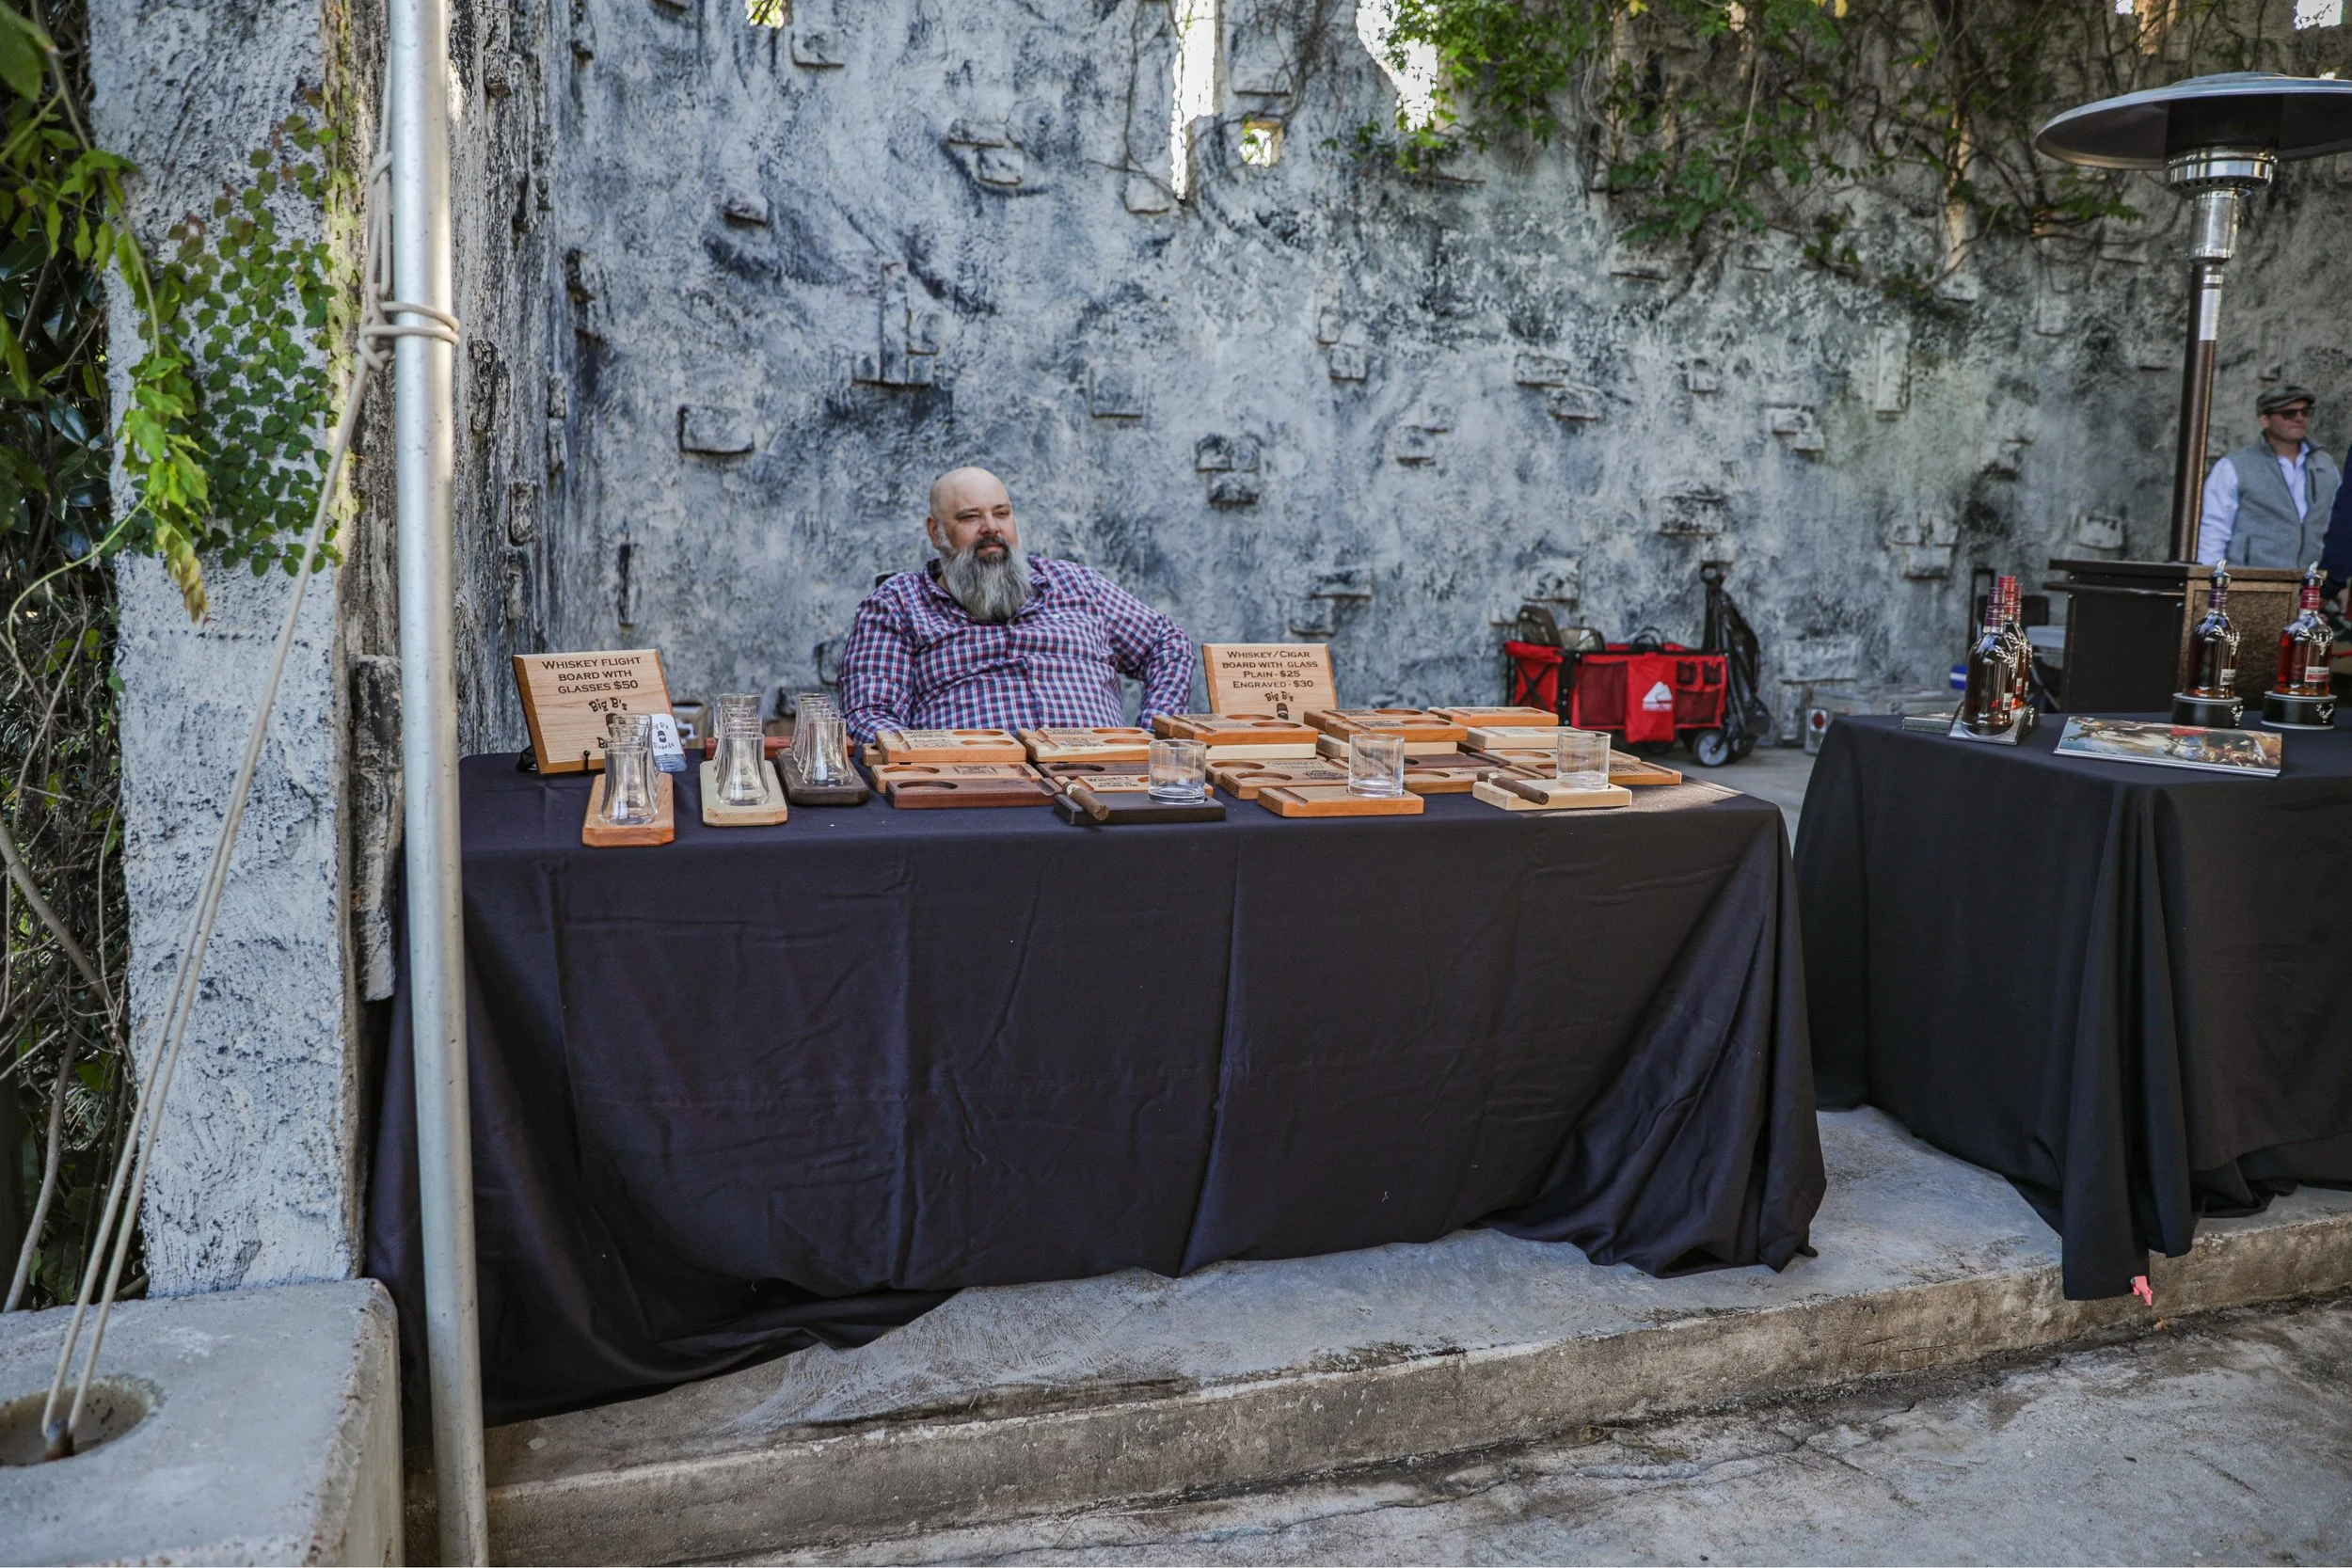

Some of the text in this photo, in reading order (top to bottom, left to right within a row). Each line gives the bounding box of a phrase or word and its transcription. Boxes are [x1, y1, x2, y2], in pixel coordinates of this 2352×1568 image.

[1227, 650, 1310, 658] WHISKEY/CIGAR
[542, 657, 642, 670] WHISKEY FLIGHT
[558, 670, 632, 682] BOARD WITH
[1279, 670, 1300, 678] $25
[557, 680, 639, 694] GLASSES $50
[1232, 680, 1287, 689] ENGRAVED
[1264, 691, 1279, 703] Big
[588, 696, 628, 713] Big B's
